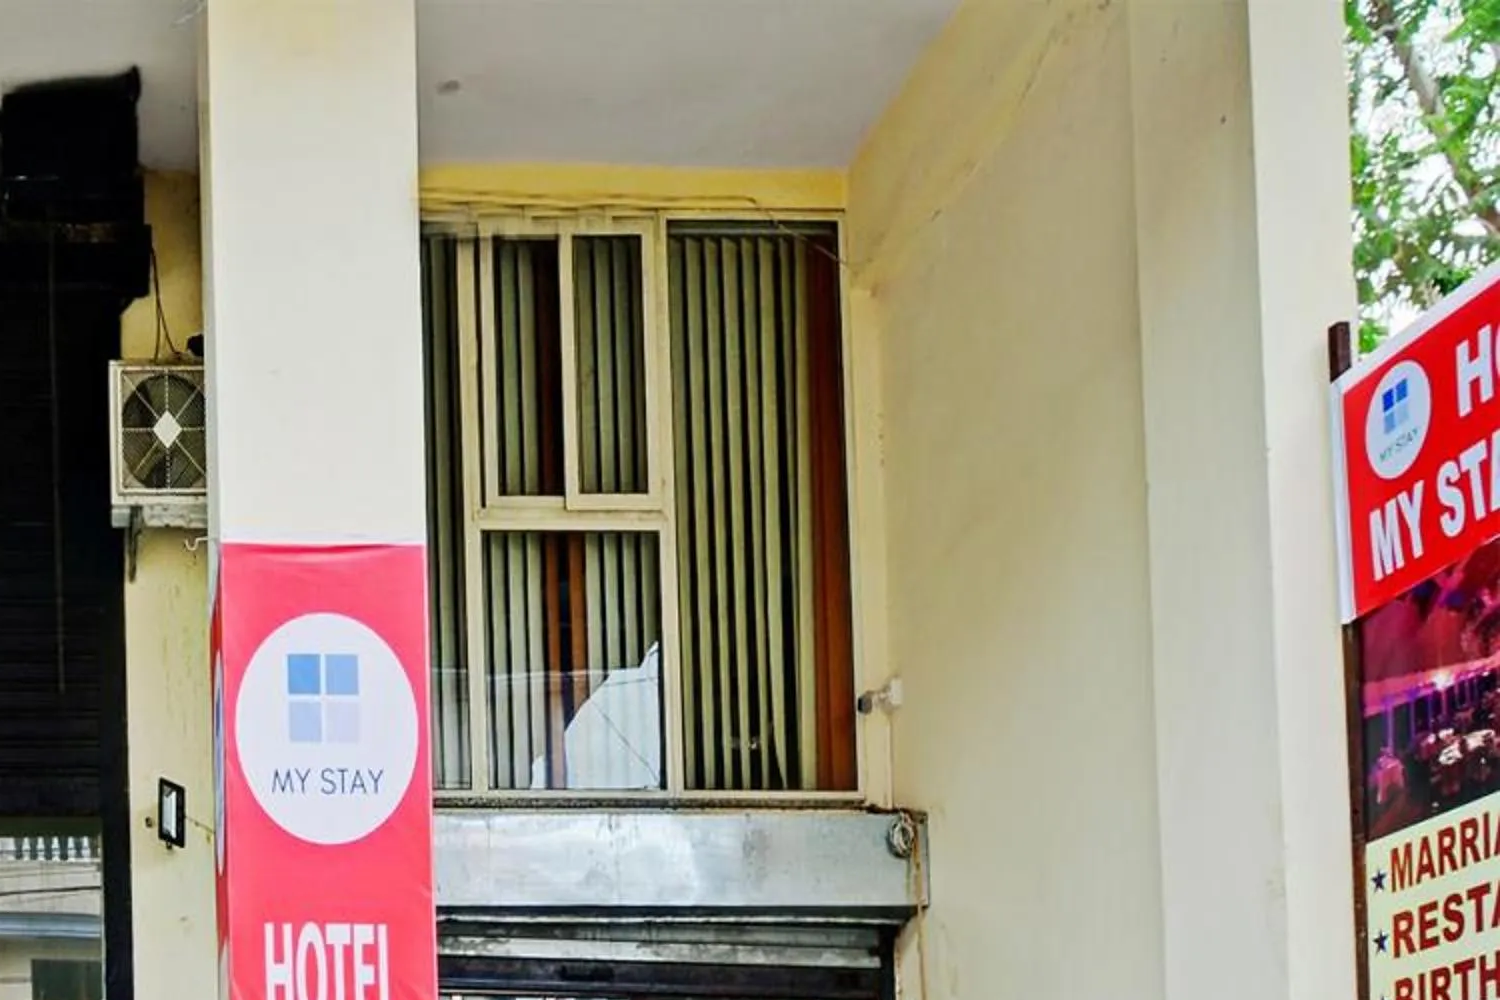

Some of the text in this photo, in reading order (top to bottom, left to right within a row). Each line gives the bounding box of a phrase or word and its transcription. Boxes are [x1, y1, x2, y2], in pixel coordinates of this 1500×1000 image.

[1456, 323, 1500, 418] H
[1369, 480, 1425, 582] MY
[272, 768, 384, 796] MY STAY
[1390, 811, 1500, 893] MARRI
